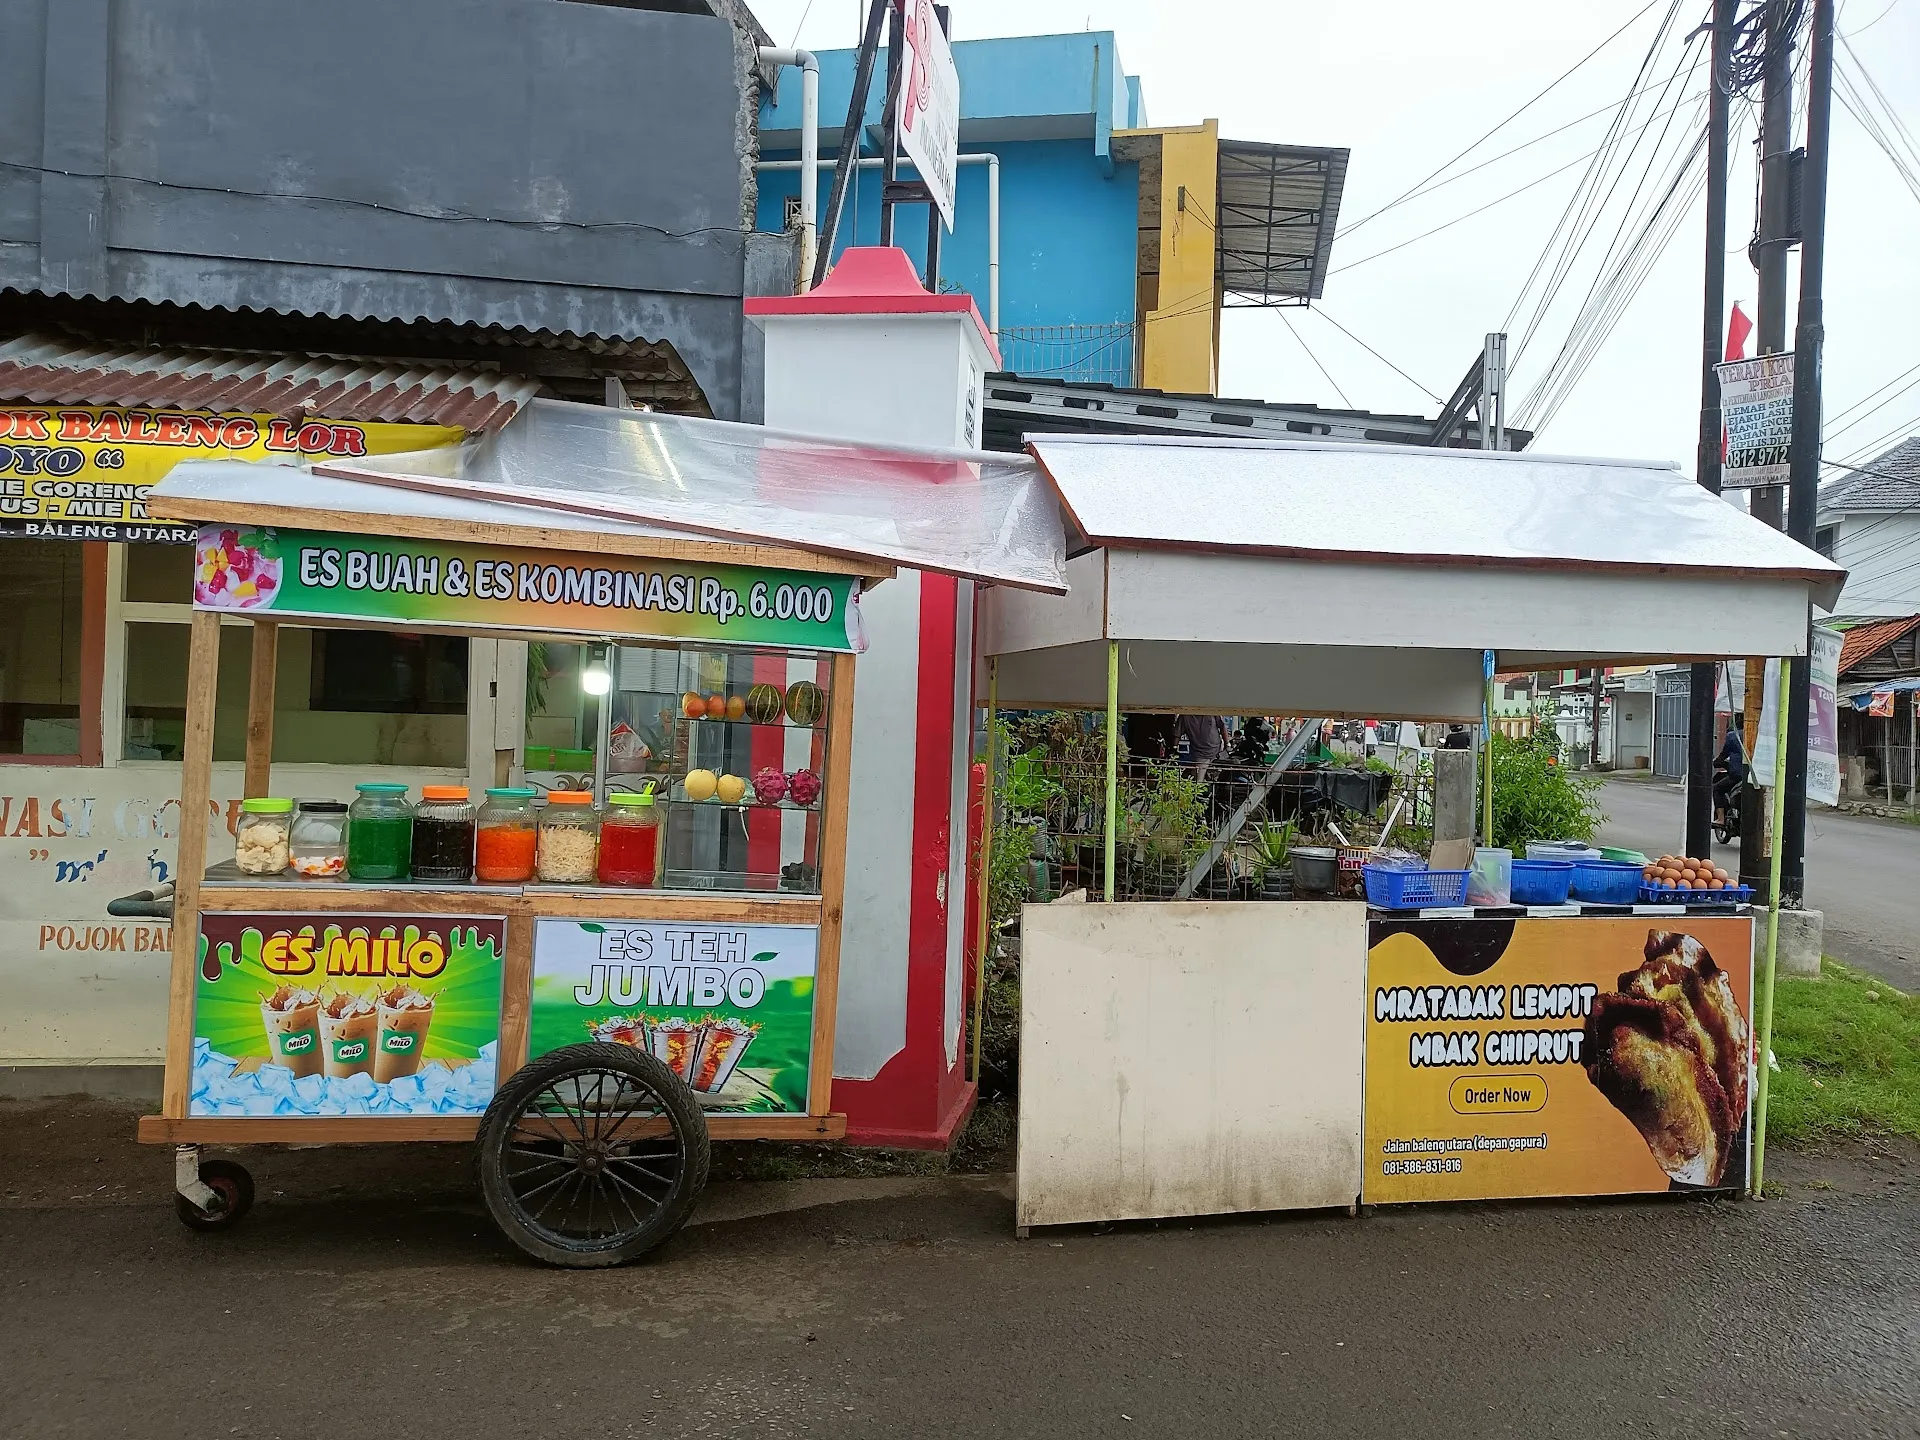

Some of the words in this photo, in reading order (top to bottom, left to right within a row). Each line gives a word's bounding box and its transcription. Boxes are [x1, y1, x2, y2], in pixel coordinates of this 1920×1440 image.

[1720, 361, 1765, 384] TERAPI
[1749, 375, 1792, 392] PRIA
[1728, 407, 1786, 425] EJAKULASI
[56, 411, 259, 449] BALENG
[265, 417, 367, 458] LOR
[1728, 423, 1758, 435] MANI
[1729, 428, 1767, 443] TAHAN
[1726, 449, 1756, 469] 0812
[1758, 446, 1788, 466] 9712
[66, 500, 123, 518] MIE
[25, 523, 117, 540] BALENG
[126, 527, 198, 541] UTARA
[301, 548, 341, 587] ES
[346, 551, 440, 595] BUAH
[443, 558, 469, 597] &
[475, 560, 514, 599] ES
[518, 562, 695, 613] KOMBINASI
[699, 577, 745, 624] Rp.
[749, 580, 834, 624] 6.000
[39, 925, 126, 952] POJOK
[599, 929, 653, 961] ES
[665, 930, 747, 963] TEH
[261, 934, 317, 974] ES
[327, 936, 449, 978] MILO
[574, 964, 765, 1008] JUMBO
[1375, 984, 1505, 1022] MRATABAK
[1511, 982, 1598, 1019] LEMPIT
[289, 1038, 310, 1048] MILO
[341, 1047, 362, 1056] MILO
[389, 1039, 411, 1047] MILO
[1410, 1032, 1480, 1067] MBAK
[1484, 1028, 1586, 1066] CHIPRUT
[1465, 1088, 1500, 1104] Order
[1503, 1087, 1531, 1103] Now
[1383, 1138, 1410, 1153] Jalan
[1411, 1137, 1446, 1154] baleng
[1446, 1137, 1472, 1151] utara
[1473, 1133, 1508, 1151] (depan
[1508, 1132, 1548, 1151] gapura)
[1383, 1158, 1462, 1175] 081-386-831-816
